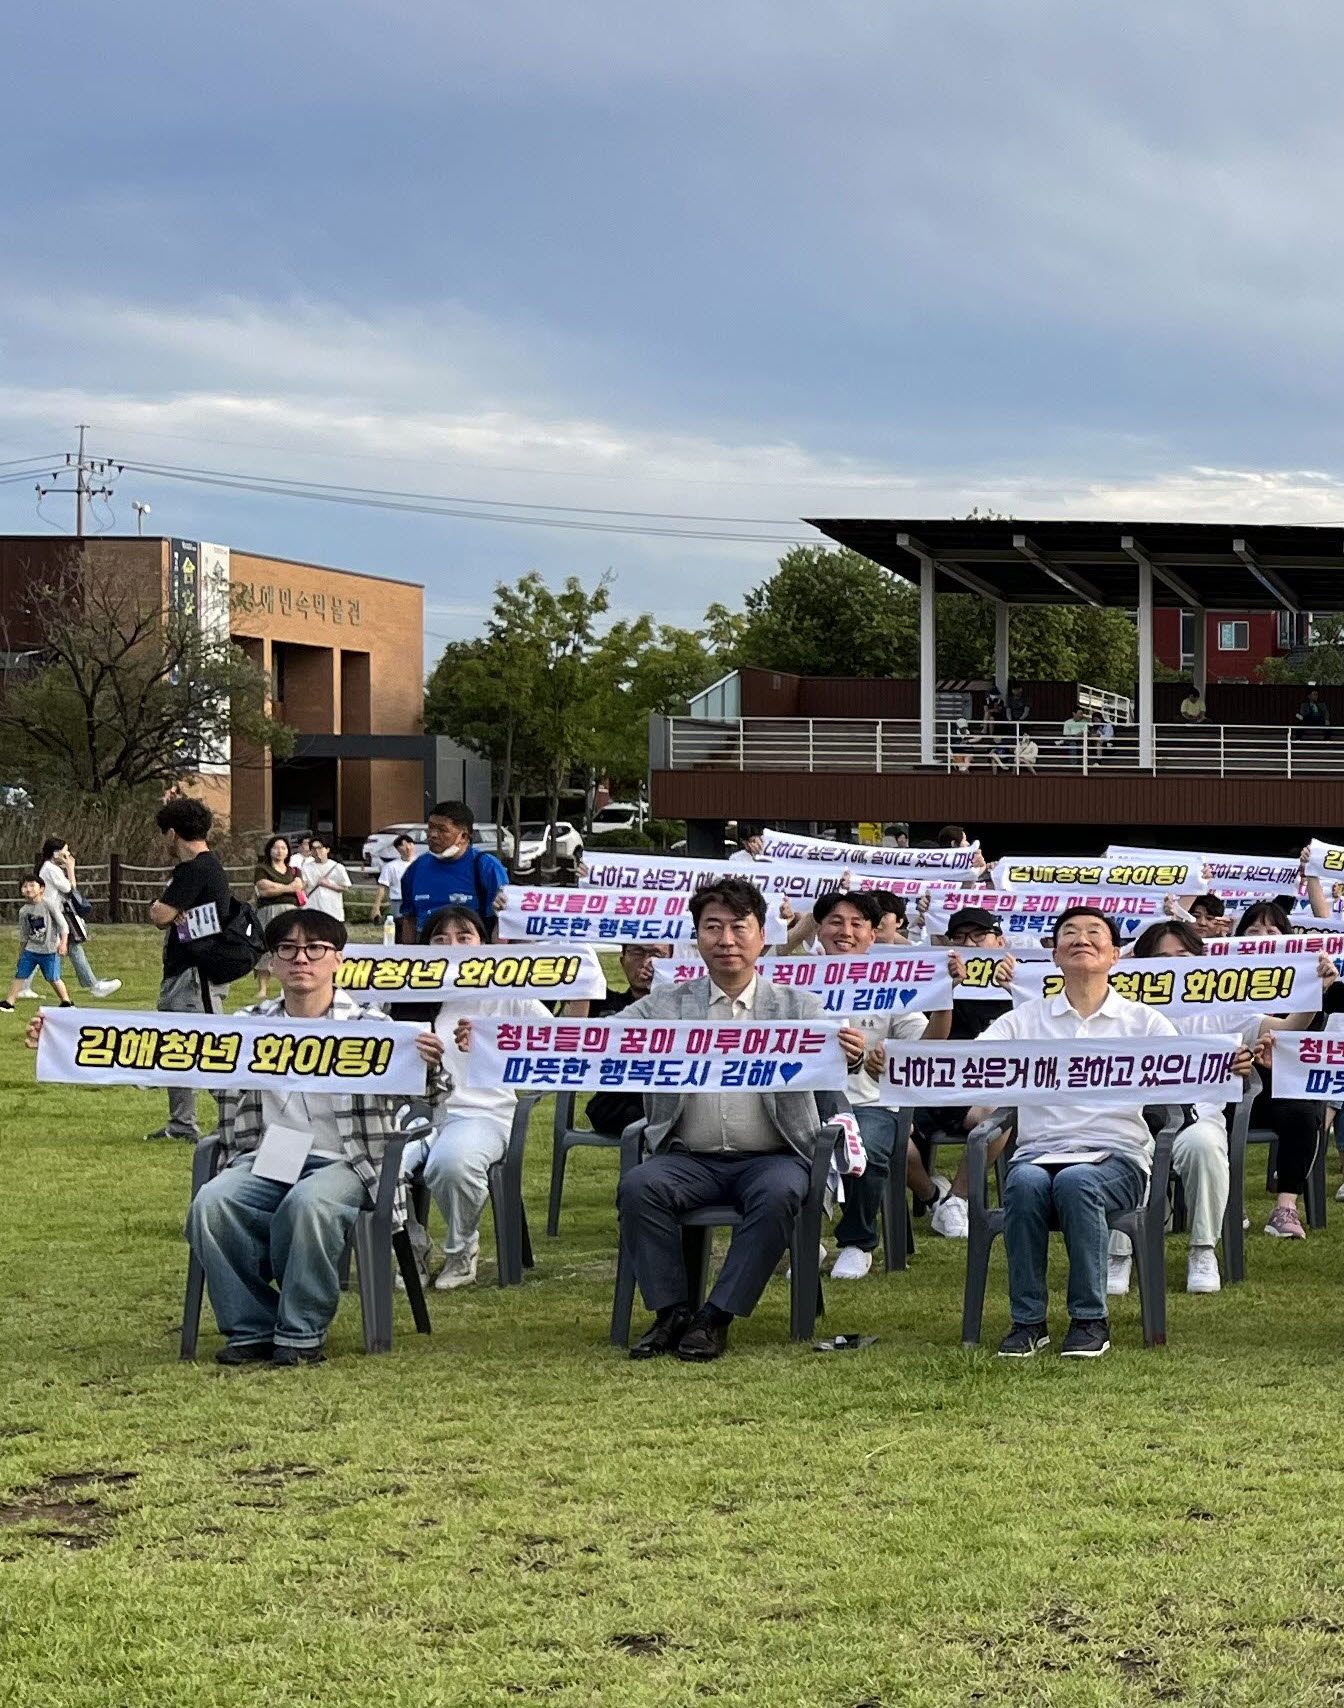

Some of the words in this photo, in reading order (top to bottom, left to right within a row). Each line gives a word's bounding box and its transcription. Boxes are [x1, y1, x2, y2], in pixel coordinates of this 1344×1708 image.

[588, 866, 638, 889] 너하고
[643, 869, 694, 891] 싶은거
[1107, 866, 1187, 885] 화이팅!
[520, 892, 609, 914] 청년들의
[615, 896, 658, 916] 꿈이
[942, 893, 1018, 911] 청년들의
[1022, 895, 1061, 912] 꿈이
[525, 917, 591, 938] 따뜻한
[599, 918, 684, 940] 행복도시
[1009, 915, 1054, 933] 행복도
[333, 955, 449, 991] 해청년
[455, 955, 582, 989] 화이팅!
[772, 963, 815, 985] 꿈이
[825, 960, 935, 983] 이루어지는
[1184, 965, 1294, 1003] 화이팅!
[852, 988, 899, 1011] 김해
[75, 1025, 242, 1074] 김해청년
[248, 1034, 394, 1077] 화이팅!
[496, 1023, 609, 1053] 청년들의
[619, 1026, 675, 1054] 꿈이
[686, 1026, 827, 1055] 이루어지는
[502, 1058, 591, 1085] 따뜻한
[599, 1059, 713, 1087] 행복도시
[719, 1060, 779, 1087] 김해
[889, 1056, 956, 1088] 너하고
[961, 1056, 1030, 1089] 싶은거
[1033, 1055, 1061, 1092] 해,
[1068, 1054, 1136, 1089] 잘하고
[1139, 1051, 1235, 1086] 있으니까!
